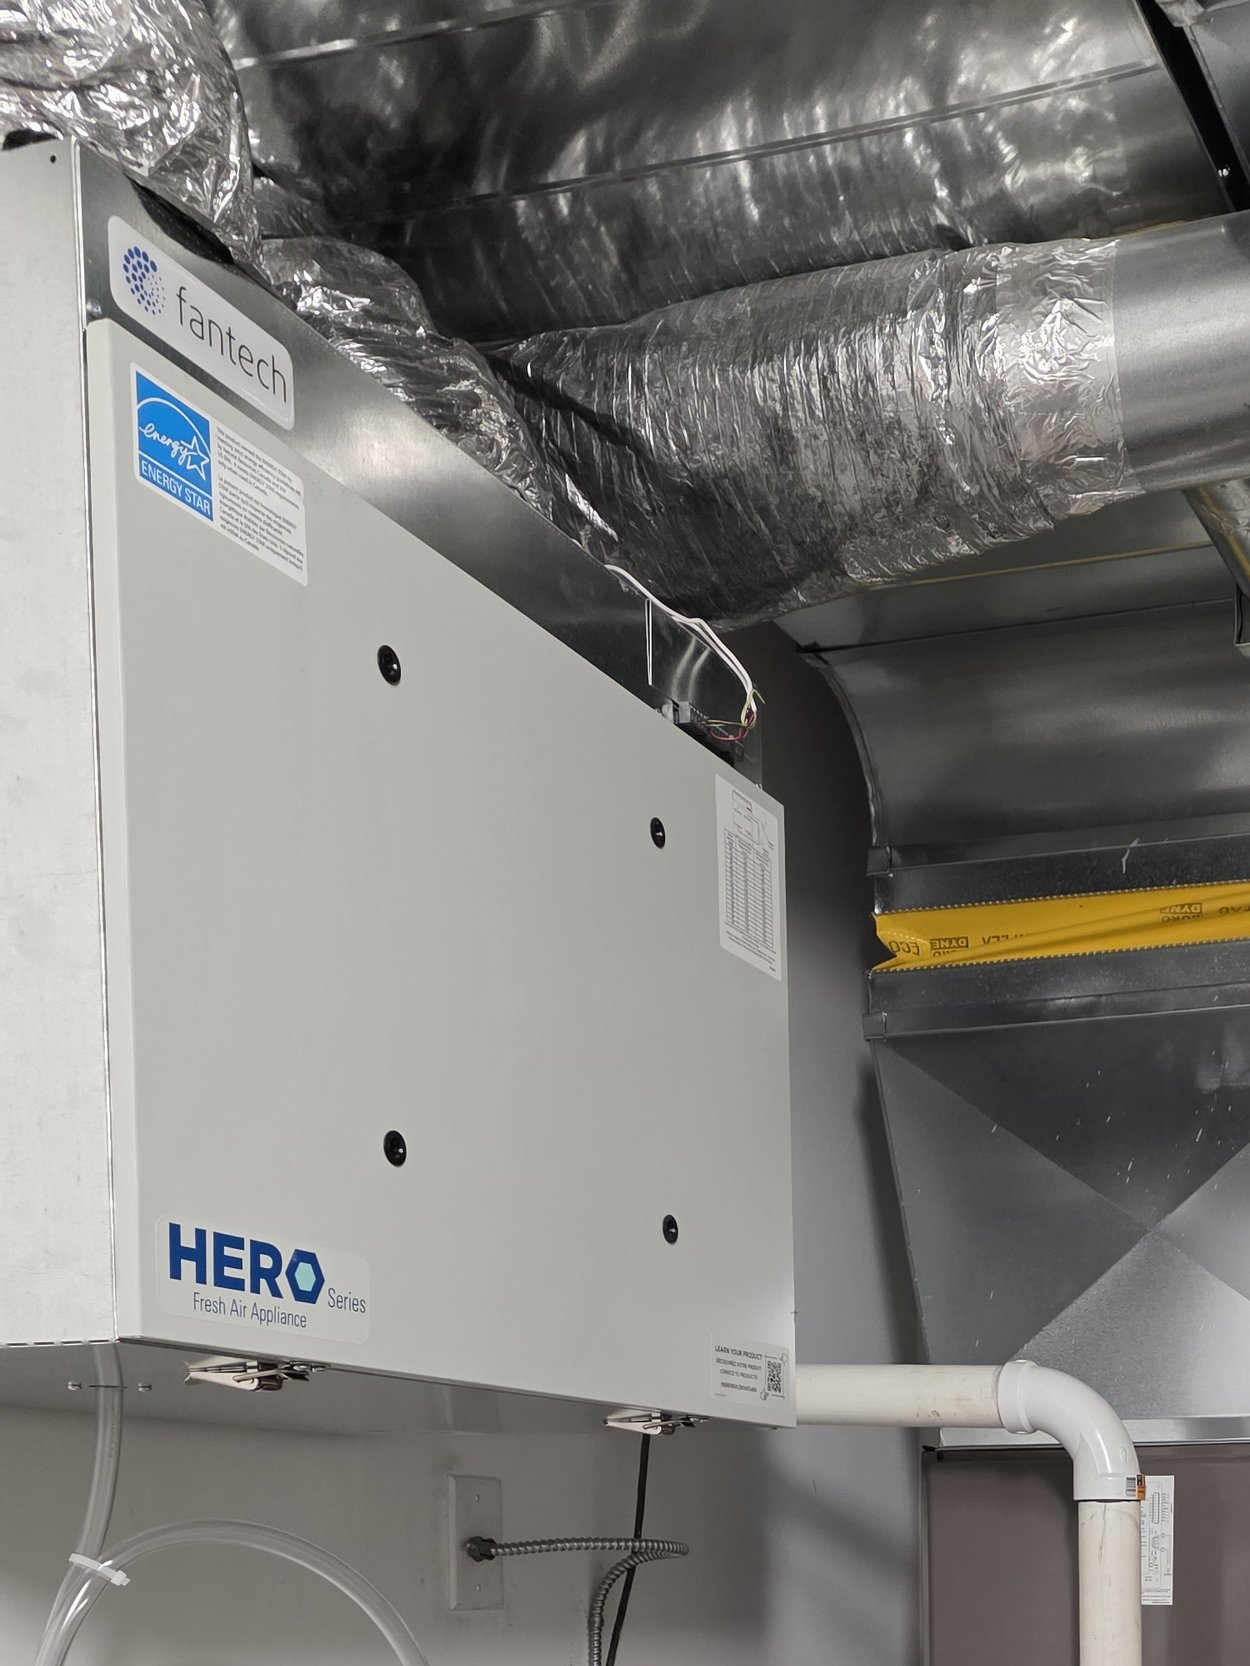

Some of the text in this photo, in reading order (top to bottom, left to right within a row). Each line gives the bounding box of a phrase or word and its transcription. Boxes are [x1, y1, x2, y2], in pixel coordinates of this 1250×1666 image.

[176, 286, 287, 403] fantech
[141, 459, 211, 516] ENERGY STAR
[932, 937, 967, 949] DYNE
[168, 1222, 325, 1304] HERO
[193, 1291, 307, 1328] Fresh Air Appliance
[327, 1287, 366, 1314] Series
[730, 1348, 742, 1357] YOUR
[743, 1350, 762, 1360] PRODUCT
